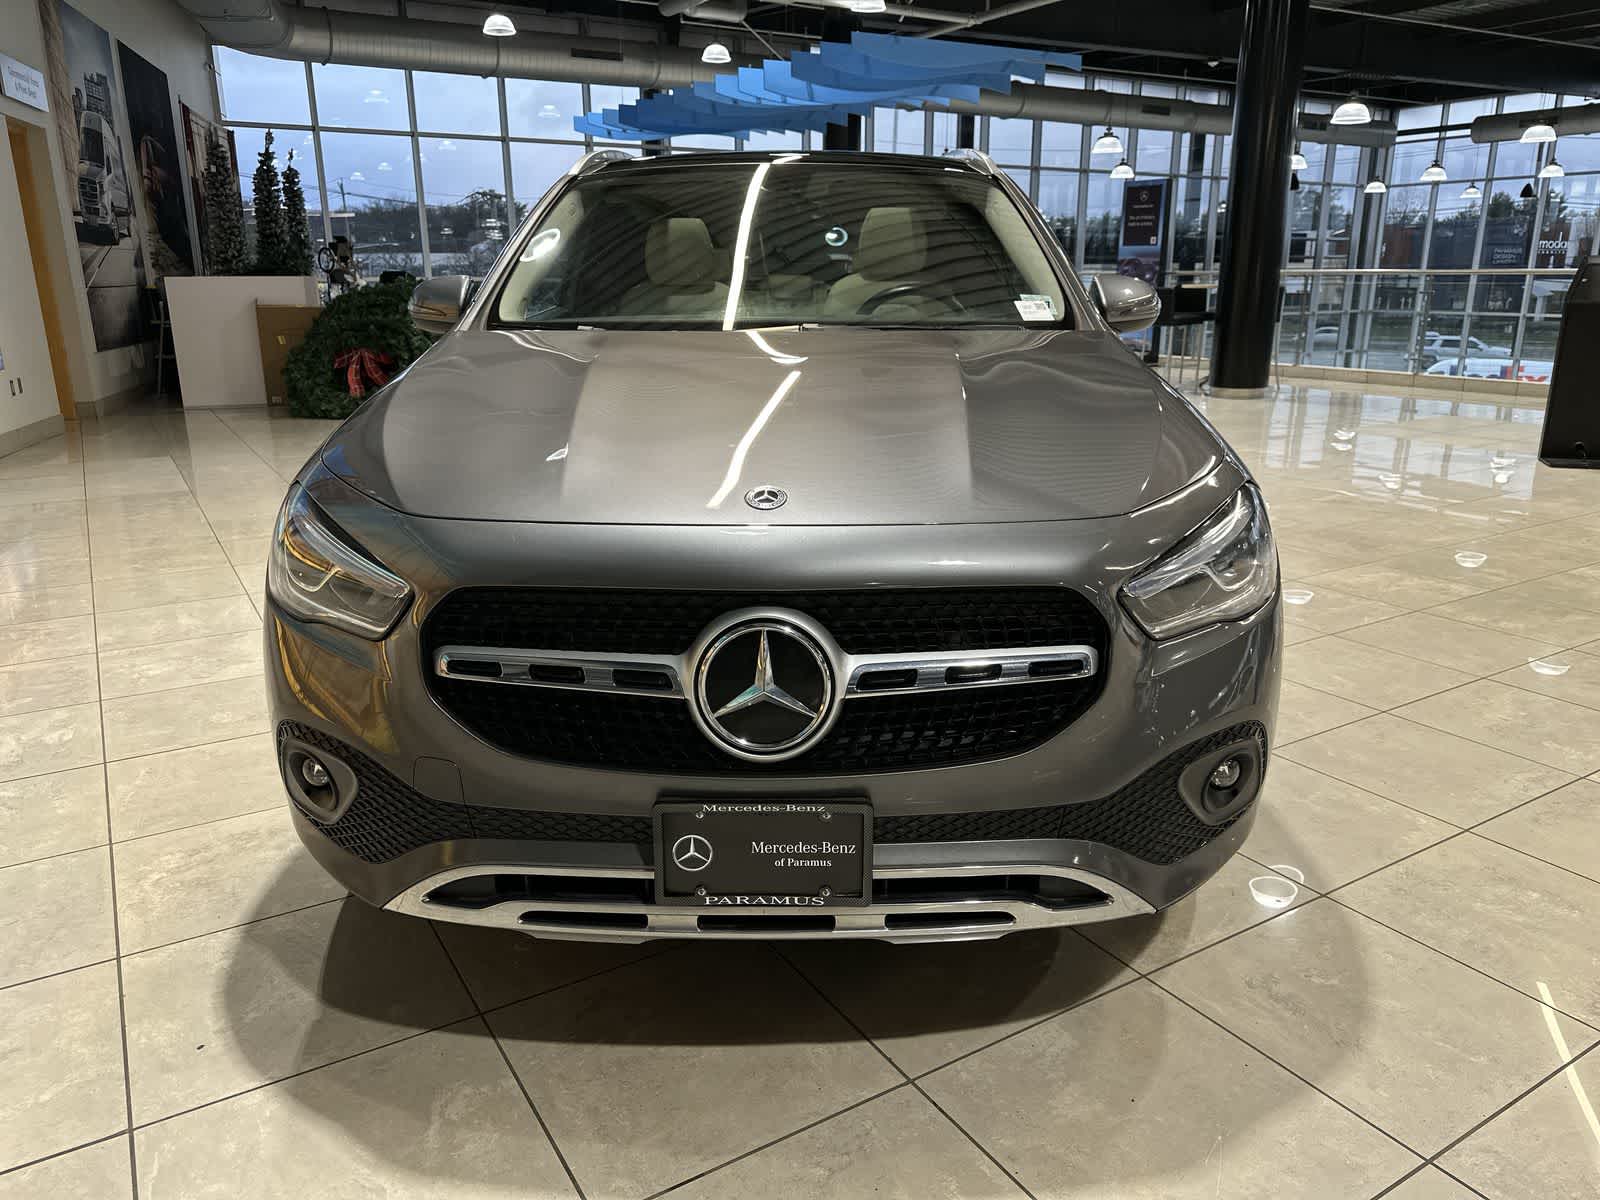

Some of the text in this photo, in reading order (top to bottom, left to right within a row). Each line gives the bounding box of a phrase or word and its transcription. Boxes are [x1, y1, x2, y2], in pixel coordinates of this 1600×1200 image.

[1538, 231, 1568, 249] moda
[702, 804, 826, 812] Mercedes-Benz
[751, 841, 856, 854] Mercedes-Benz
[774, 857, 832, 867] of Paramus
[704, 895, 825, 905] PARAMUS
